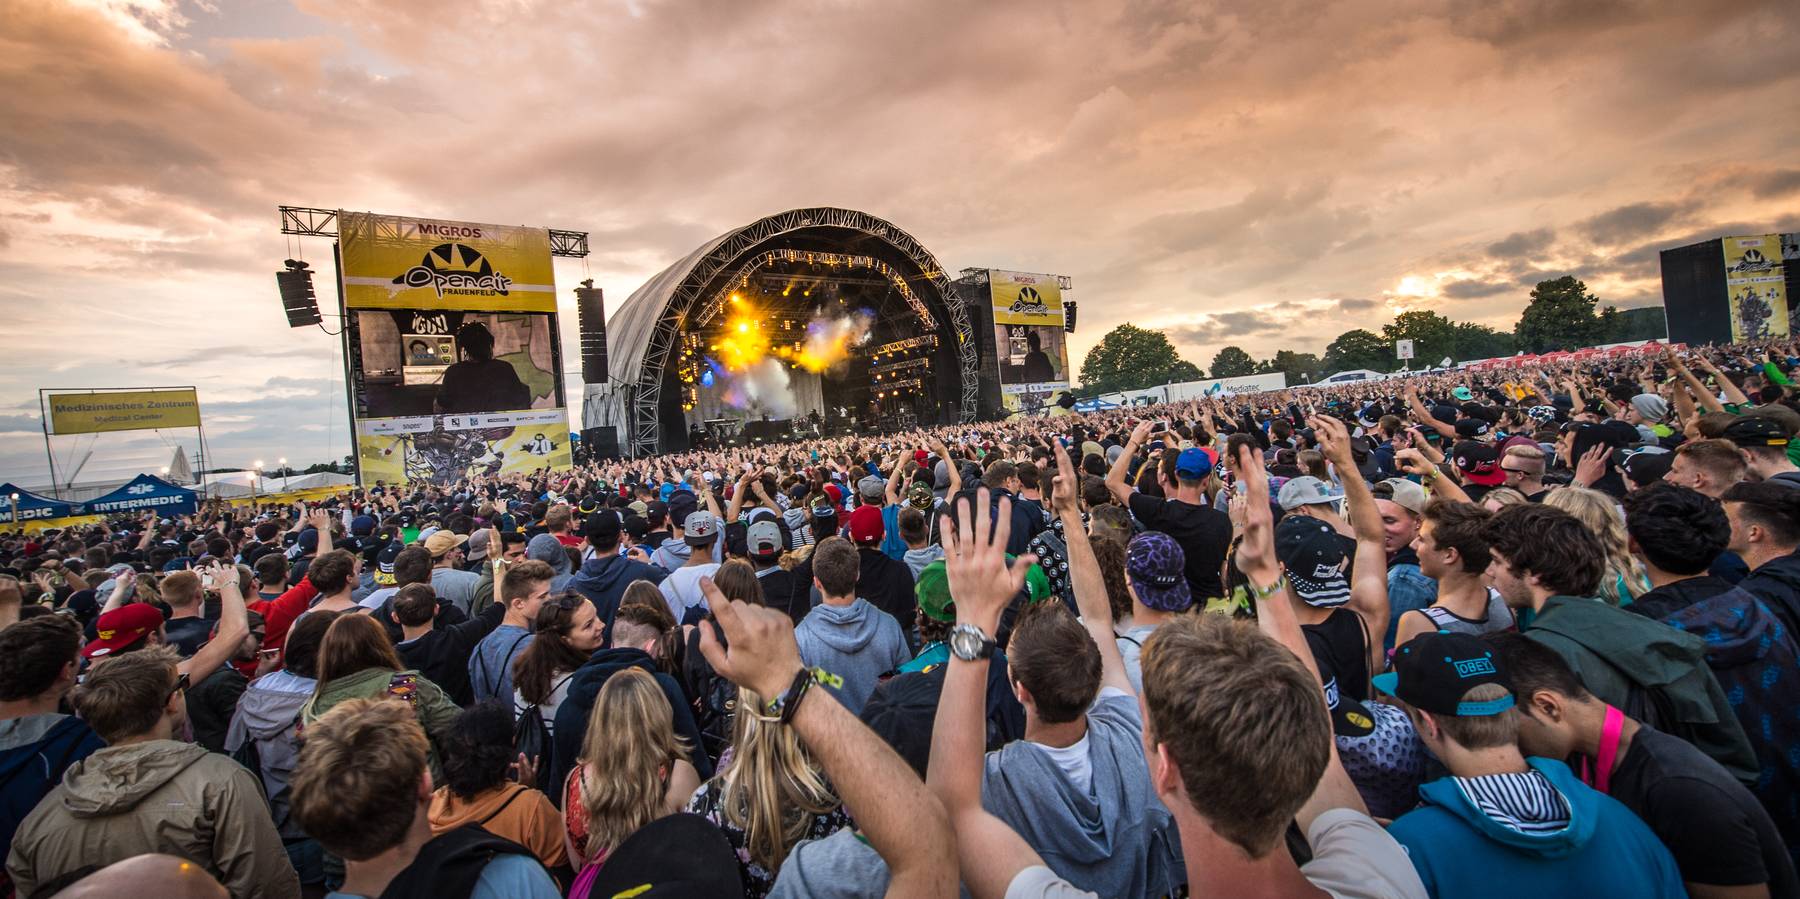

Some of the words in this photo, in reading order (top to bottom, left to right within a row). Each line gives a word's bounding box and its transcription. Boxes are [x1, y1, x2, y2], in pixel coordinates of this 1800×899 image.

[418, 224, 482, 238] MIGROS
[404, 266, 512, 300] Openair
[442, 288, 496, 297] FRAUENFELD
[1226, 384, 1260, 393] Mediatec
[55, 402, 144, 413] Medizinisches
[147, 400, 195, 409] Zentrum
[94, 414, 131, 423] Medical
[134, 413, 163, 421] Center
[530, 438, 552, 454] 20
[94, 495, 184, 511] INTERMEDIC
[1459, 660, 1491, 674] OBEY
